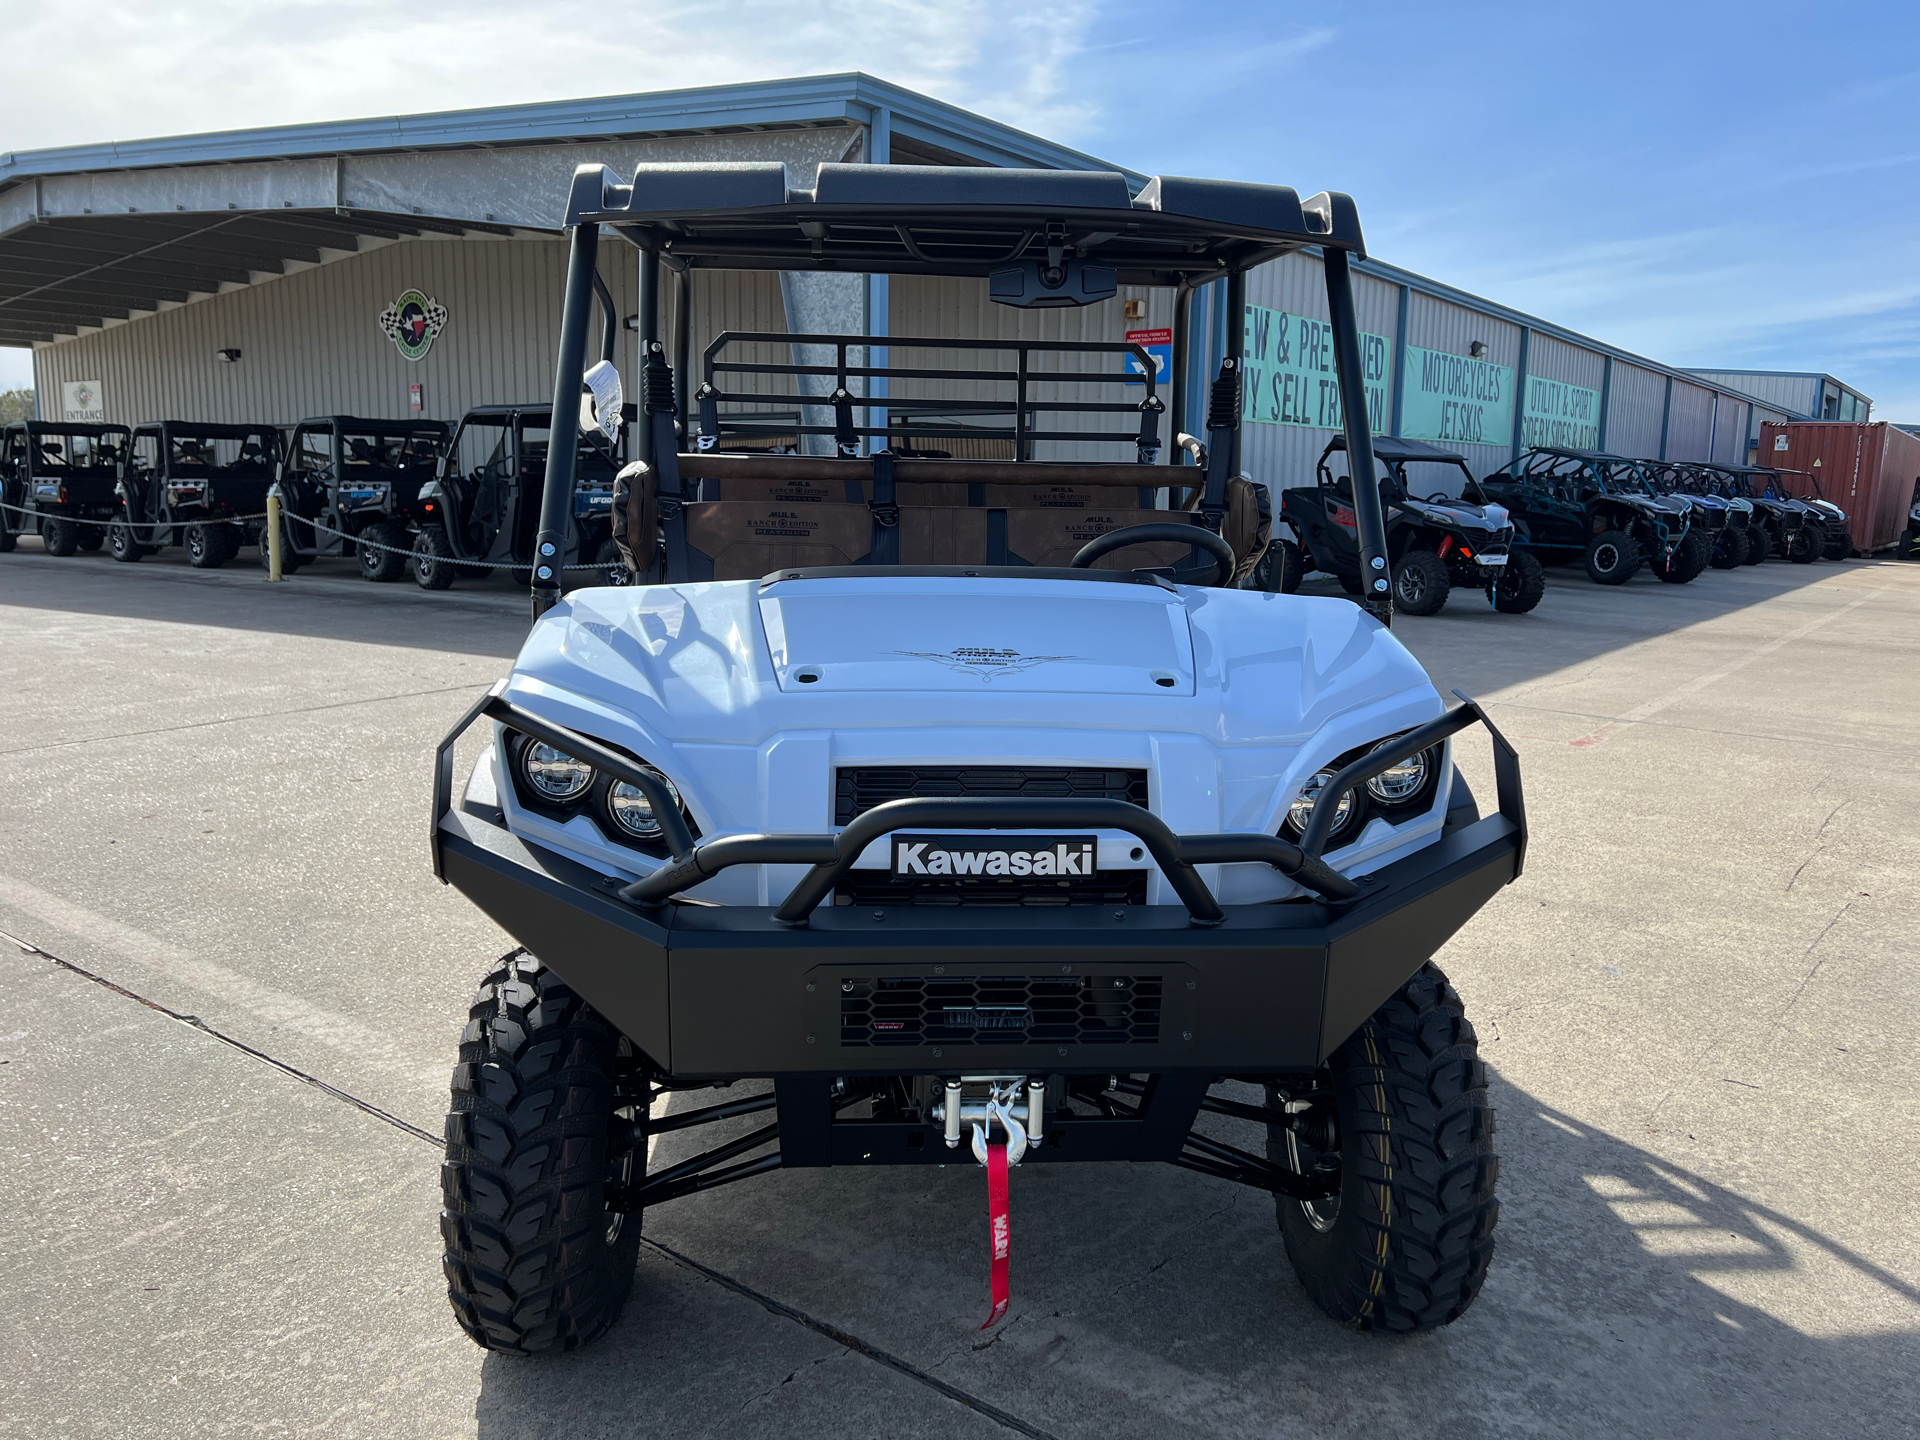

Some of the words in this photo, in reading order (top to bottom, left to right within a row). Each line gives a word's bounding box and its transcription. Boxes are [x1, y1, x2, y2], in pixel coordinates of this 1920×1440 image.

[1243, 306, 1271, 361] EW
[1277, 312, 1291, 366] &
[1421, 350, 1502, 403] MOTORCYCLES
[66, 410, 104, 421] ENTRANCE
[1270, 371, 1311, 425] SELL
[1530, 379, 1562, 416] UTILITY
[1562, 385, 1569, 417] &
[1570, 388, 1594, 421] SPORT
[590, 496, 614, 504] UFOR
[768, 511, 798, 519] MULE
[755, 528, 810, 537] PLATINUM
[897, 843, 1093, 876] Kawasaki
[993, 1213, 1009, 1261] WARN
